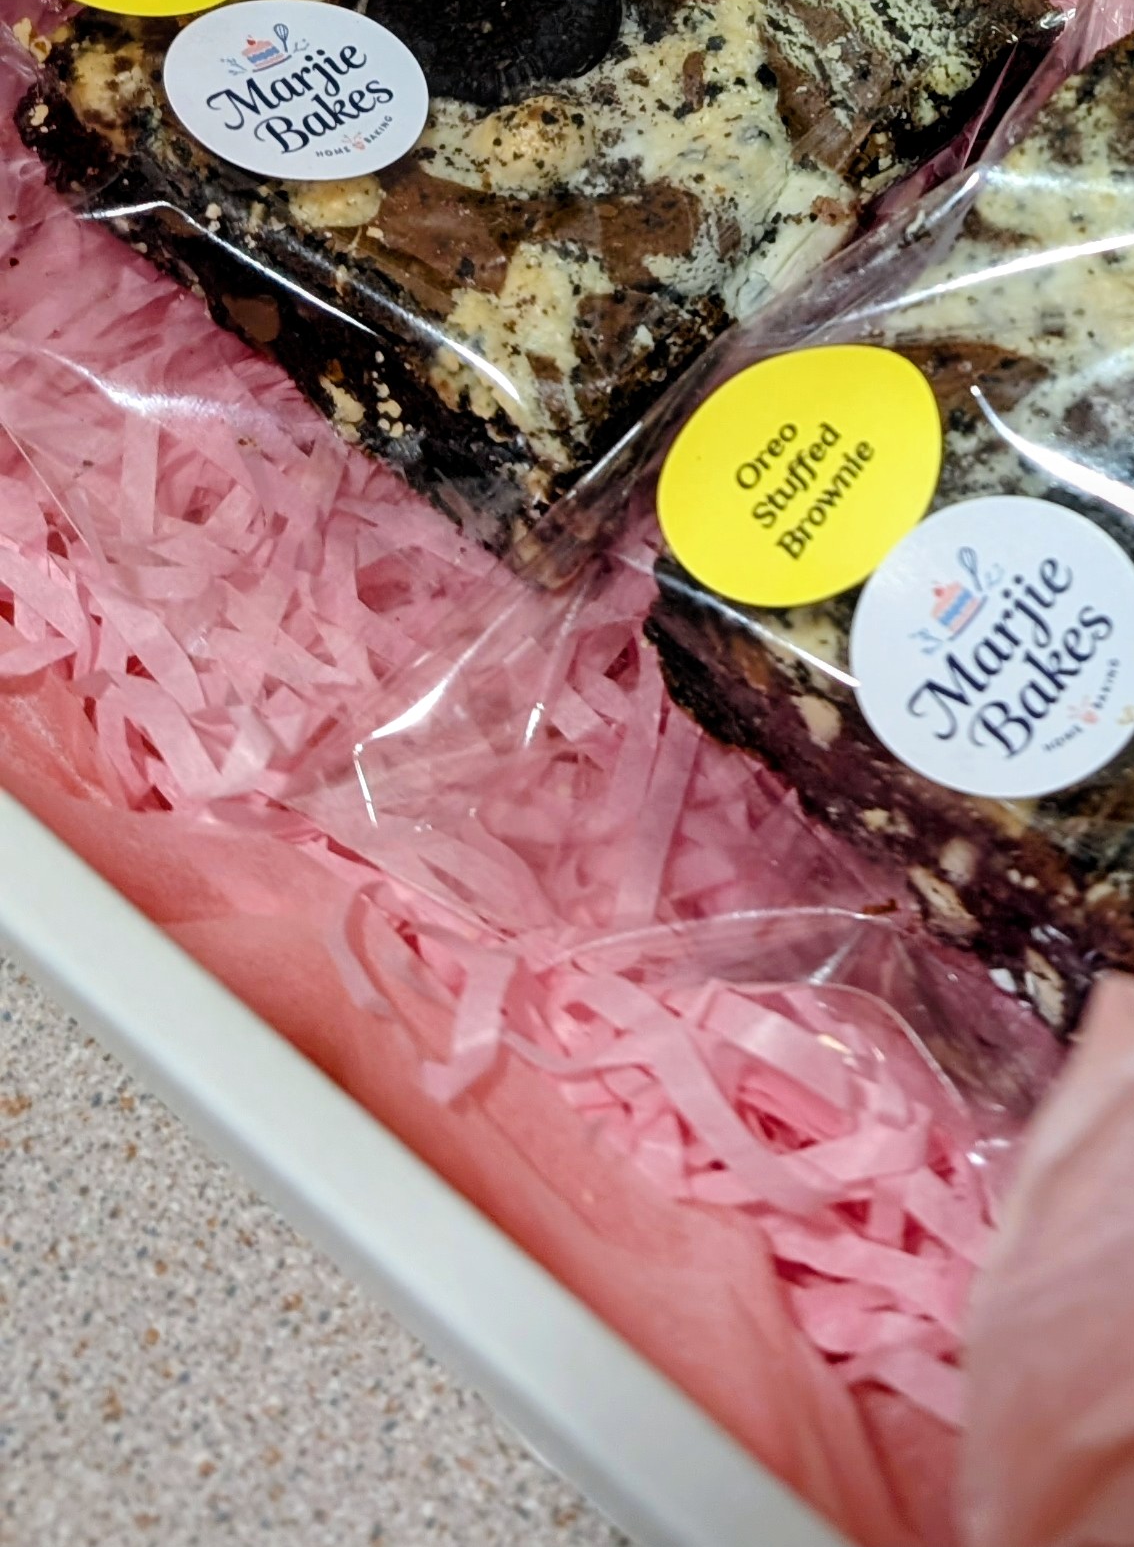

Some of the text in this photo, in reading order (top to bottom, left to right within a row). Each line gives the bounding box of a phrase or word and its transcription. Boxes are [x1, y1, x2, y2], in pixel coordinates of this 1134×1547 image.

[207, 42, 367, 130] Marjie
[254, 79, 394, 154] Bakes
[316, 115, 393, 158] HOME BAKING
[736, 421, 798, 491] Oreo
[751, 422, 842, 530] Stuffed
[774, 440, 875, 561] Brownie
[907, 556, 1074, 742] Marjie
[970, 604, 1114, 759] Bakes
